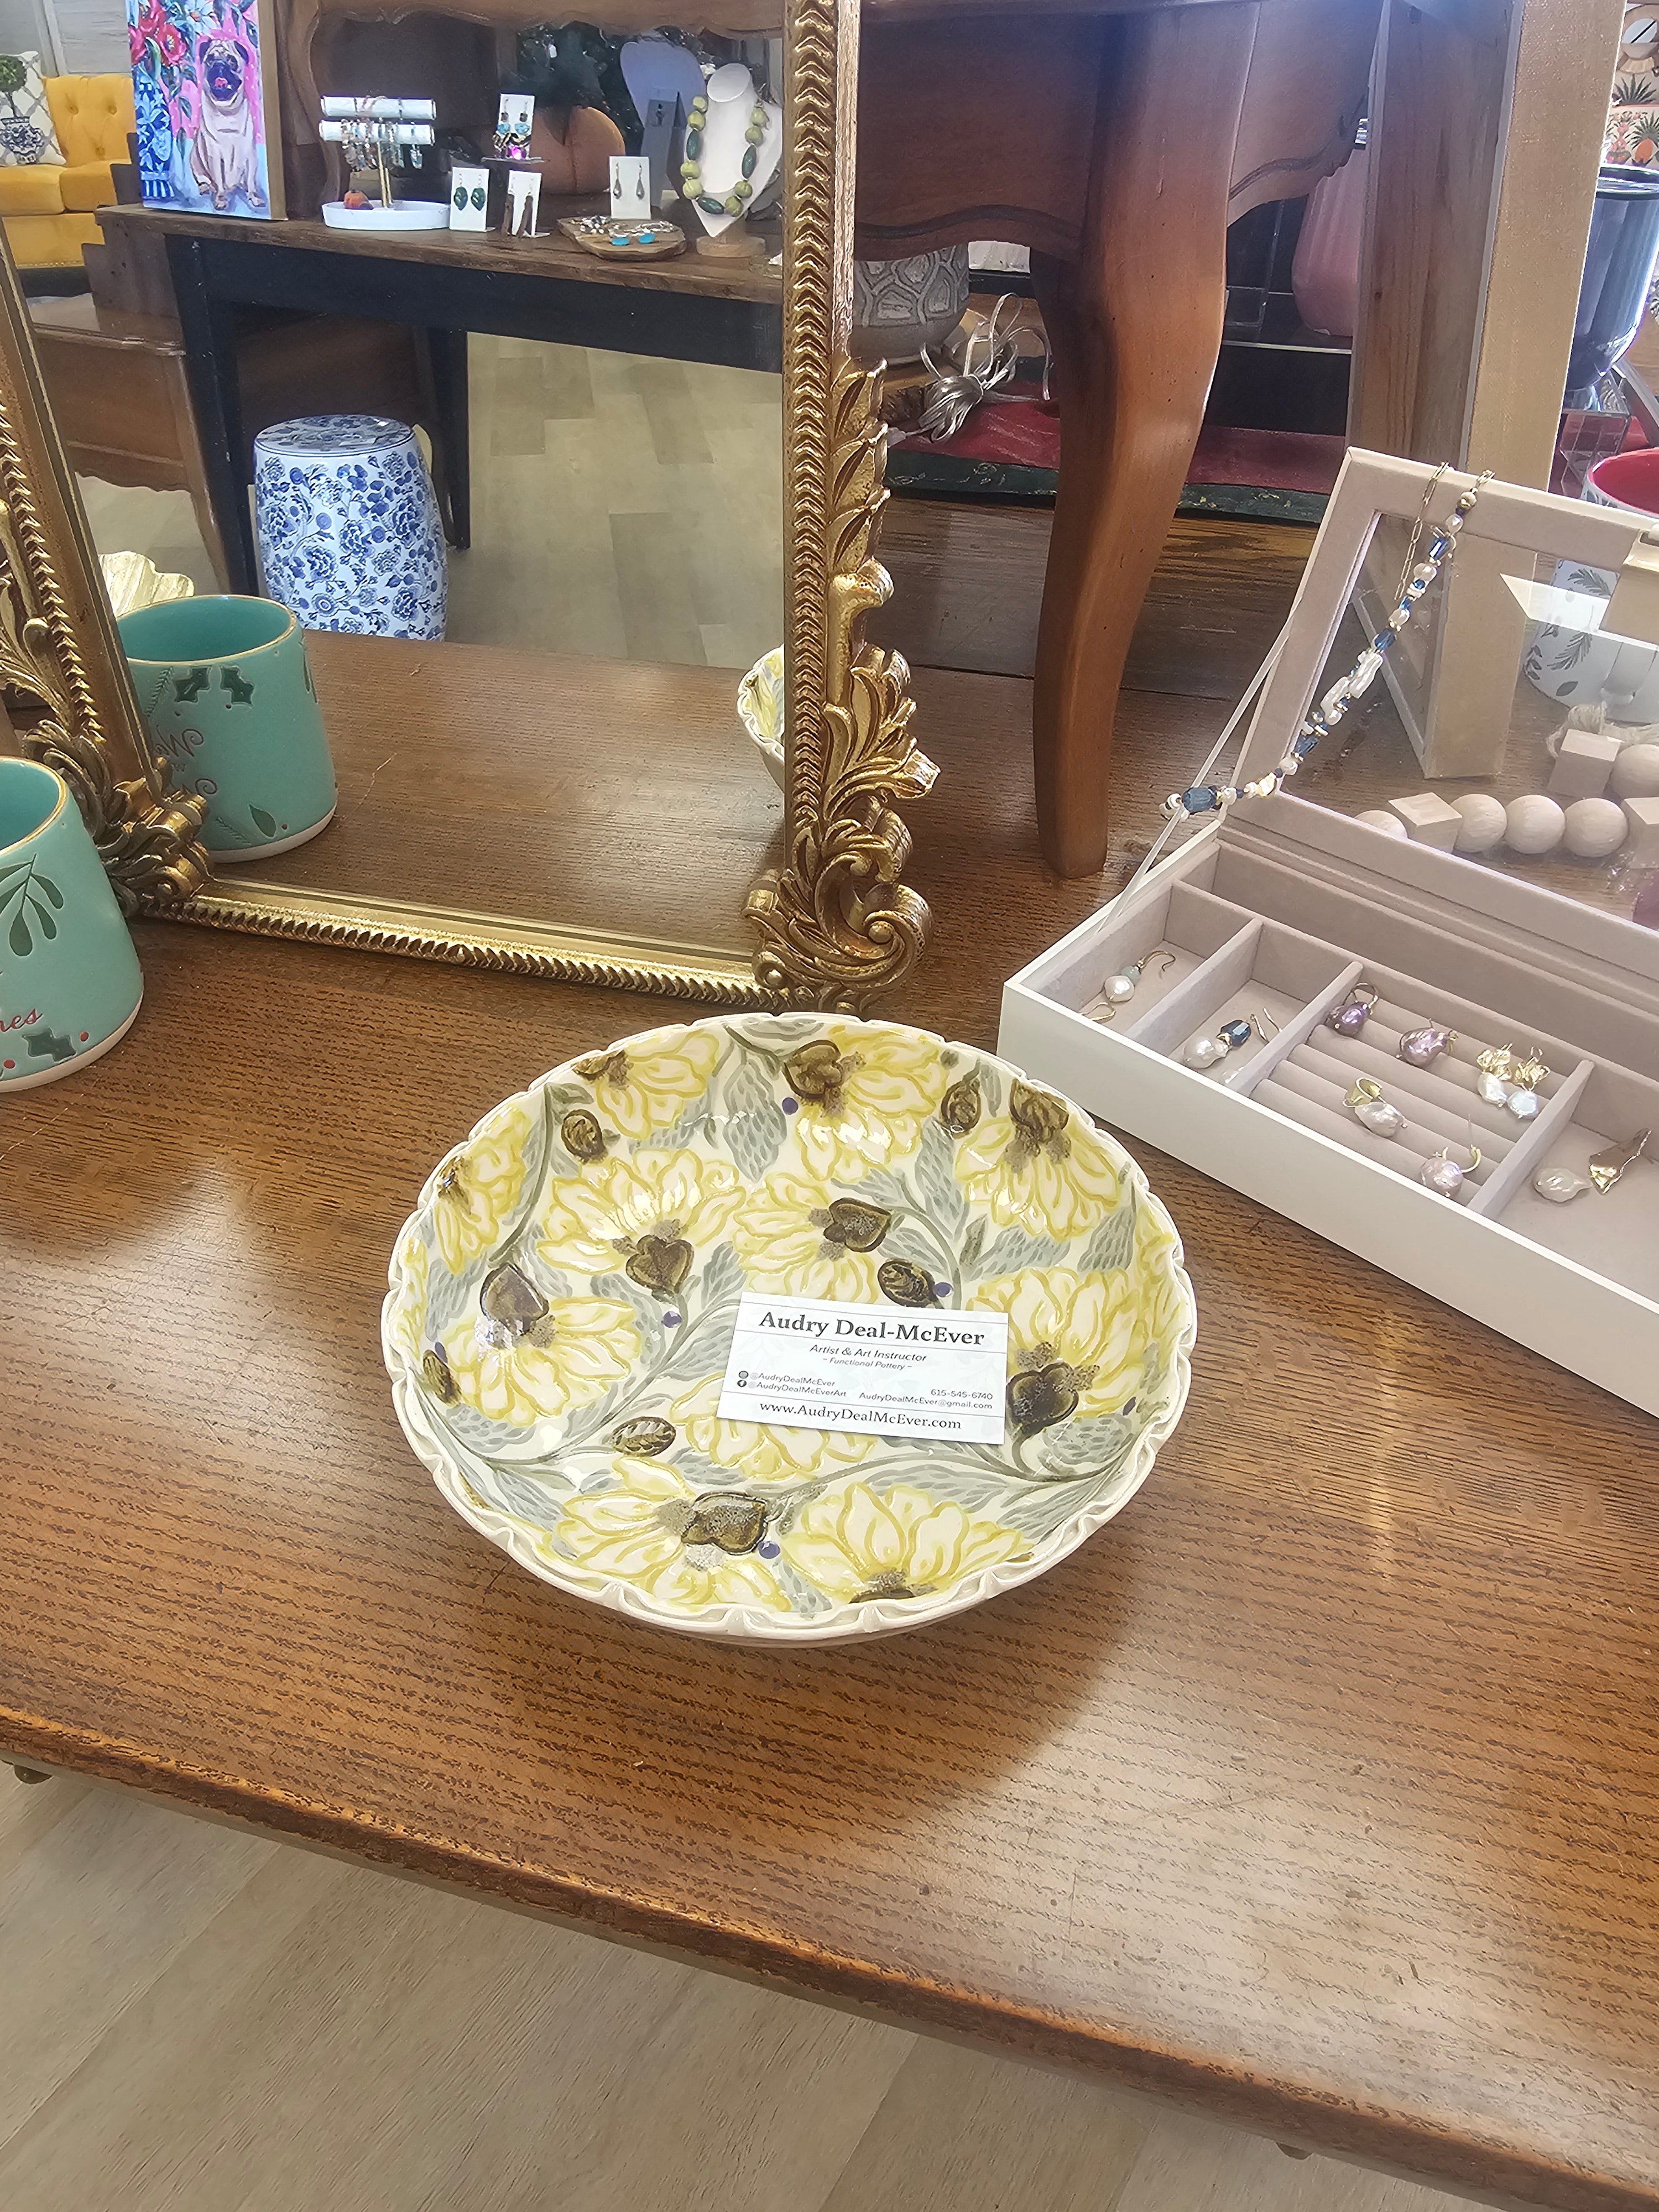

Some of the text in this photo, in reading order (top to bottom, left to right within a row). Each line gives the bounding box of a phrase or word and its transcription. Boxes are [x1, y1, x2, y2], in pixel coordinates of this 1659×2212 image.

[758, 1311, 985, 1345] Audry Deal-McEver
[809, 1344, 927, 1361] Artist & Art Instructor
[829, 1357, 873, 1367] Functional
[875, 1361, 905, 1371] Pottery
[750, 1372, 835, 1386] @AudryDealMcEver
[748, 1381, 847, 1397] @AudryDealMcEverArt
[931, 1389, 993, 1400] 615-545-6740
[859, 1392, 993, 1410] AudryDealMcEver@gmail.com
[760, 1402, 962, 1430] www.AudryDealMcEver.com
